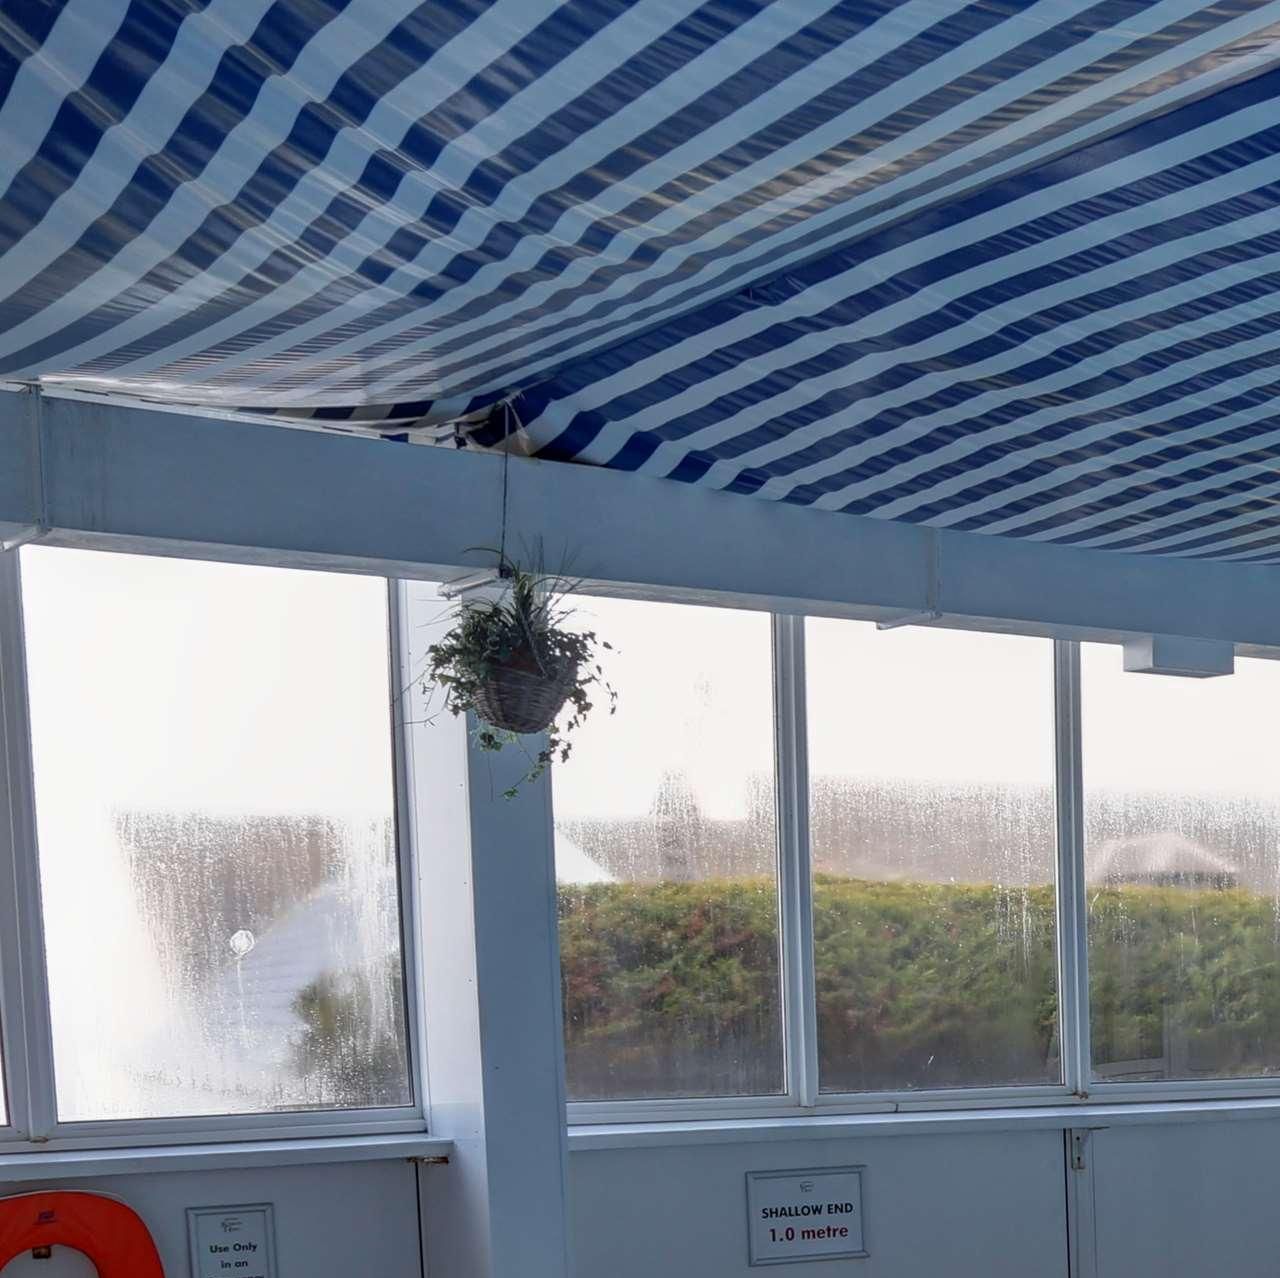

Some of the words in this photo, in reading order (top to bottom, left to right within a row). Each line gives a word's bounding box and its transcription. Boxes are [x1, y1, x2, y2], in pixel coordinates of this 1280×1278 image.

[761, 1204, 823, 1219] SHALLOW
[827, 1202, 853, 1215] END
[769, 1227, 795, 1242] 1.0
[801, 1225, 848, 1240] metre
[209, 1244, 230, 1254] Use
[233, 1242, 258, 1252] Only
[234, 1260, 248, 1268] an
